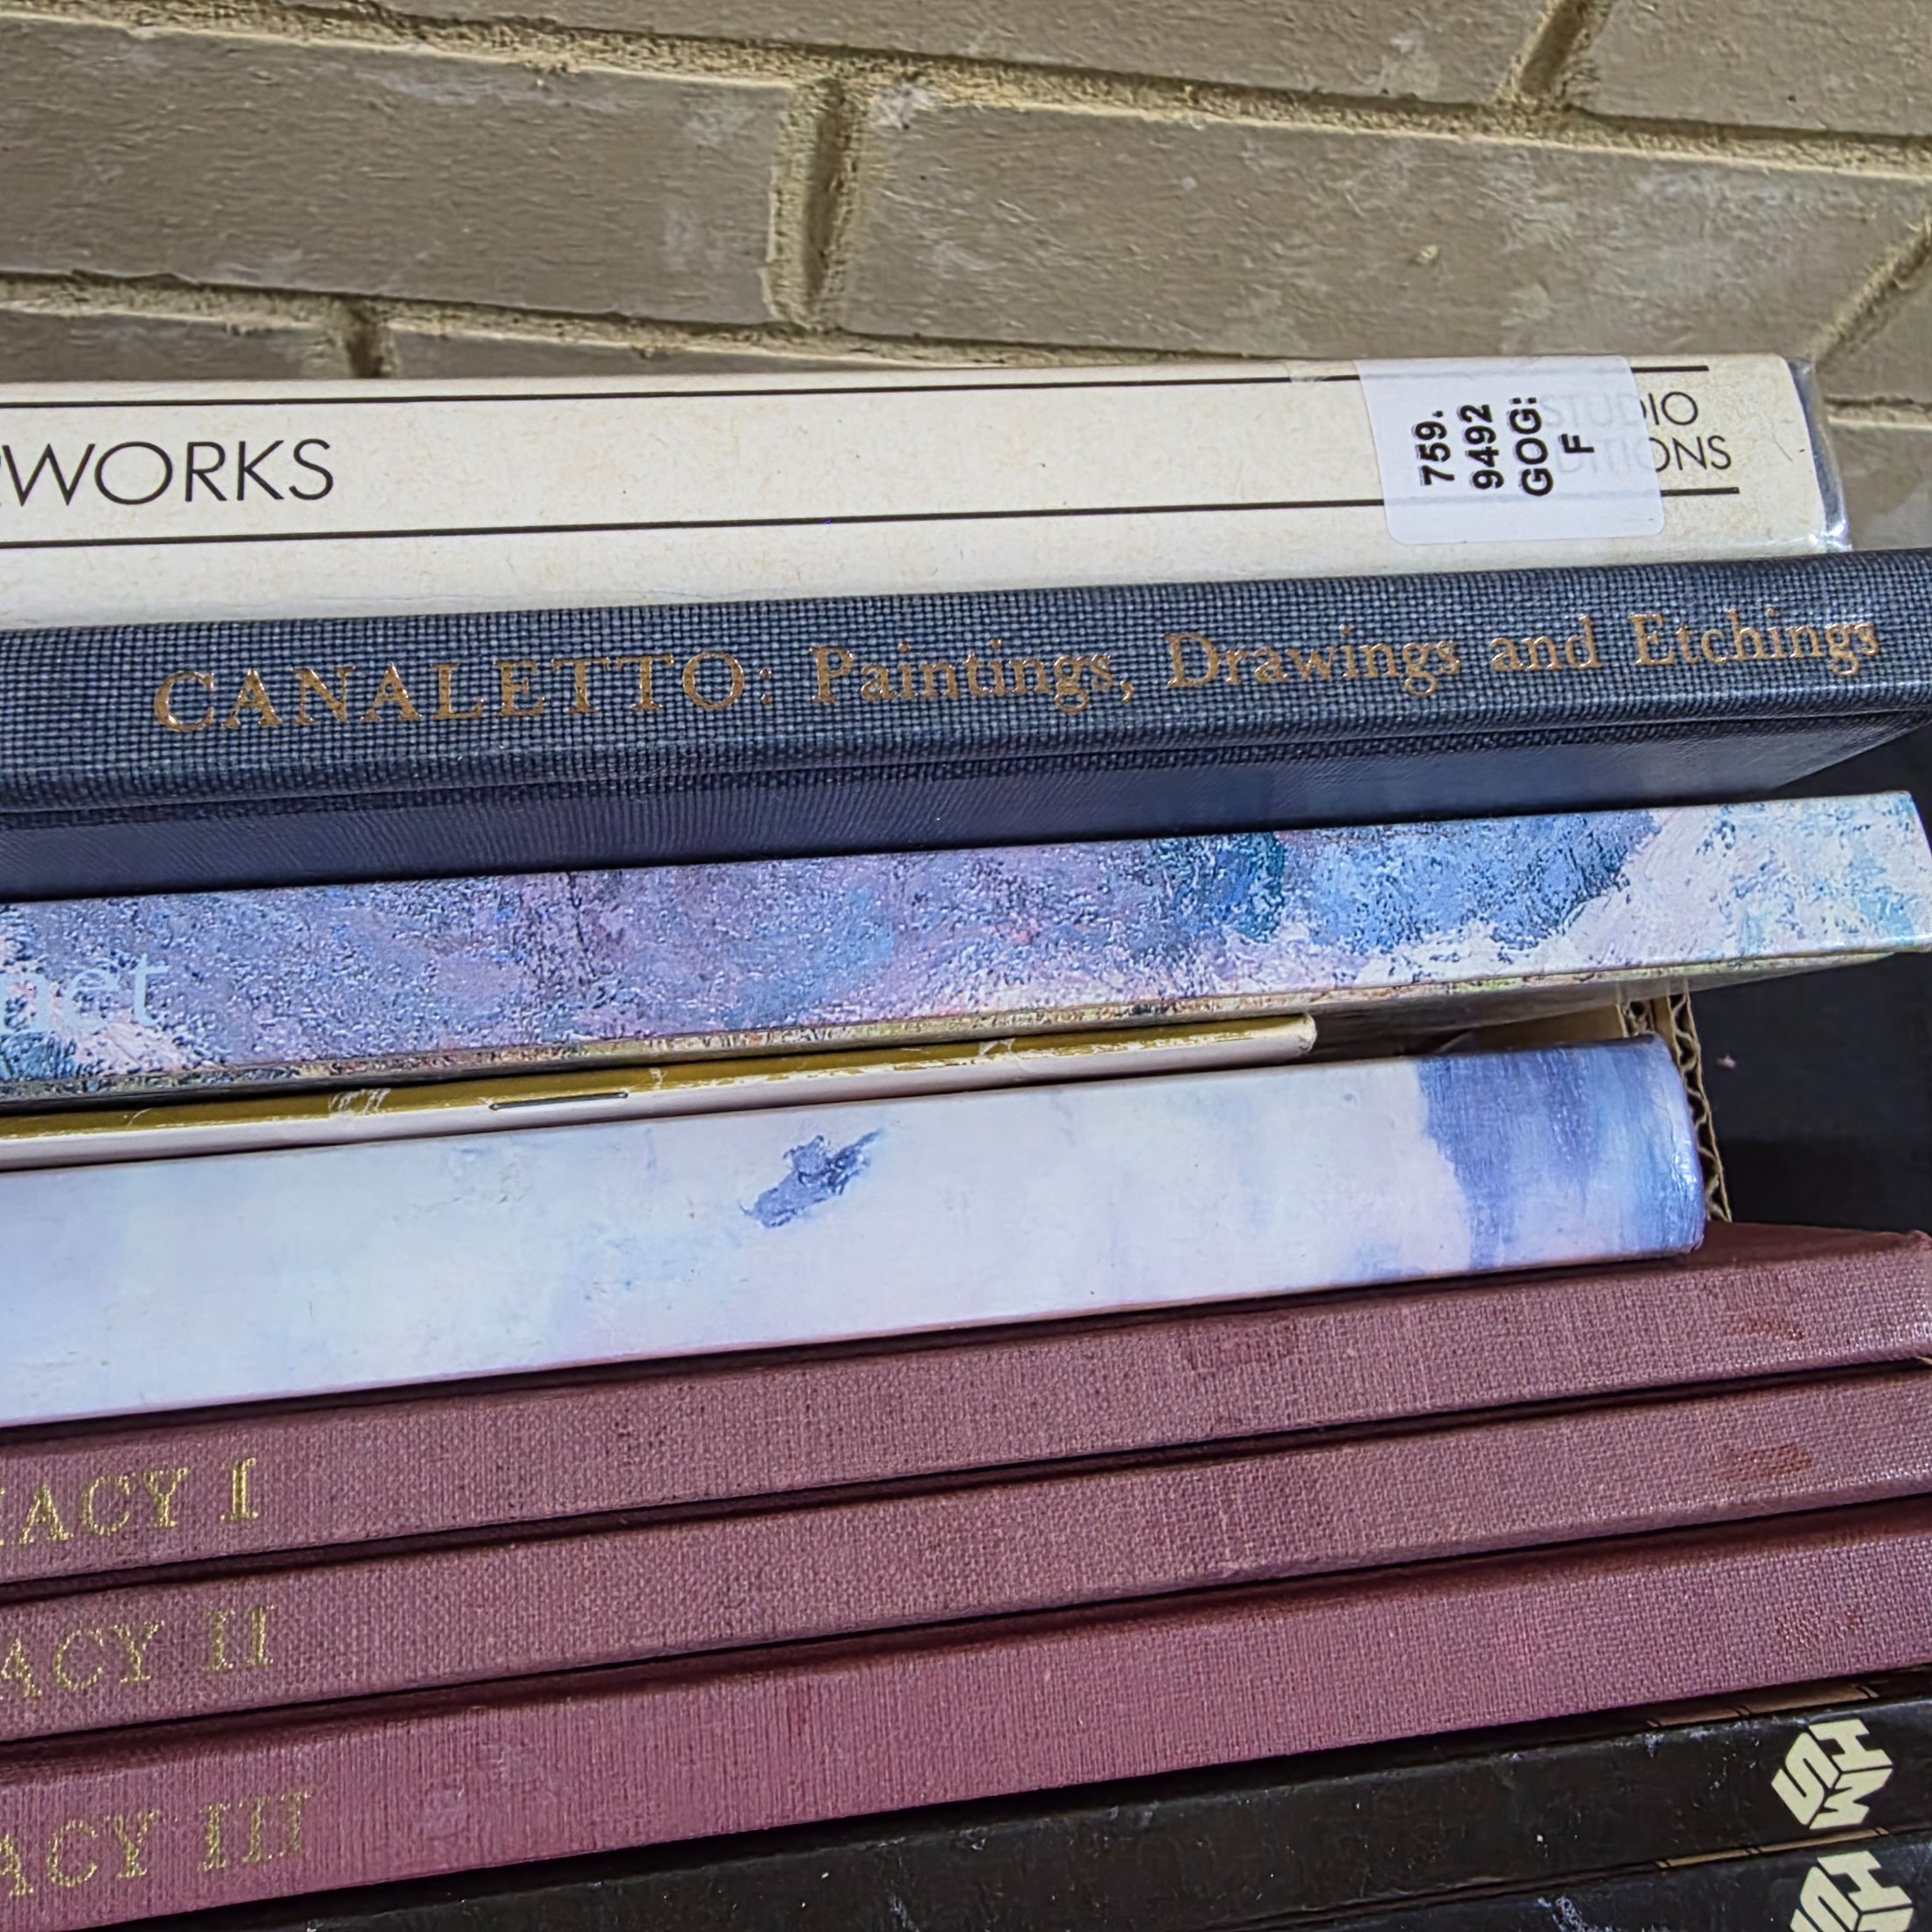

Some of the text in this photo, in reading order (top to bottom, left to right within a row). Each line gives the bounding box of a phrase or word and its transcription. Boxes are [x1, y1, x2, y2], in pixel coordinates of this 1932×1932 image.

[1412, 410, 1455, 487] 759.
[1457, 404, 1504, 490] 9492
[1507, 397, 1554, 496] GOG:
[1558, 433, 1595, 454] F
[154, 605, 1881, 732] CANALETTO: Paintings, Drawings and Etchings
[0, 1457, 259, 1546] ACY I
[202, 1604, 276, 1670] II
[198, 1790, 312, 1872] III
